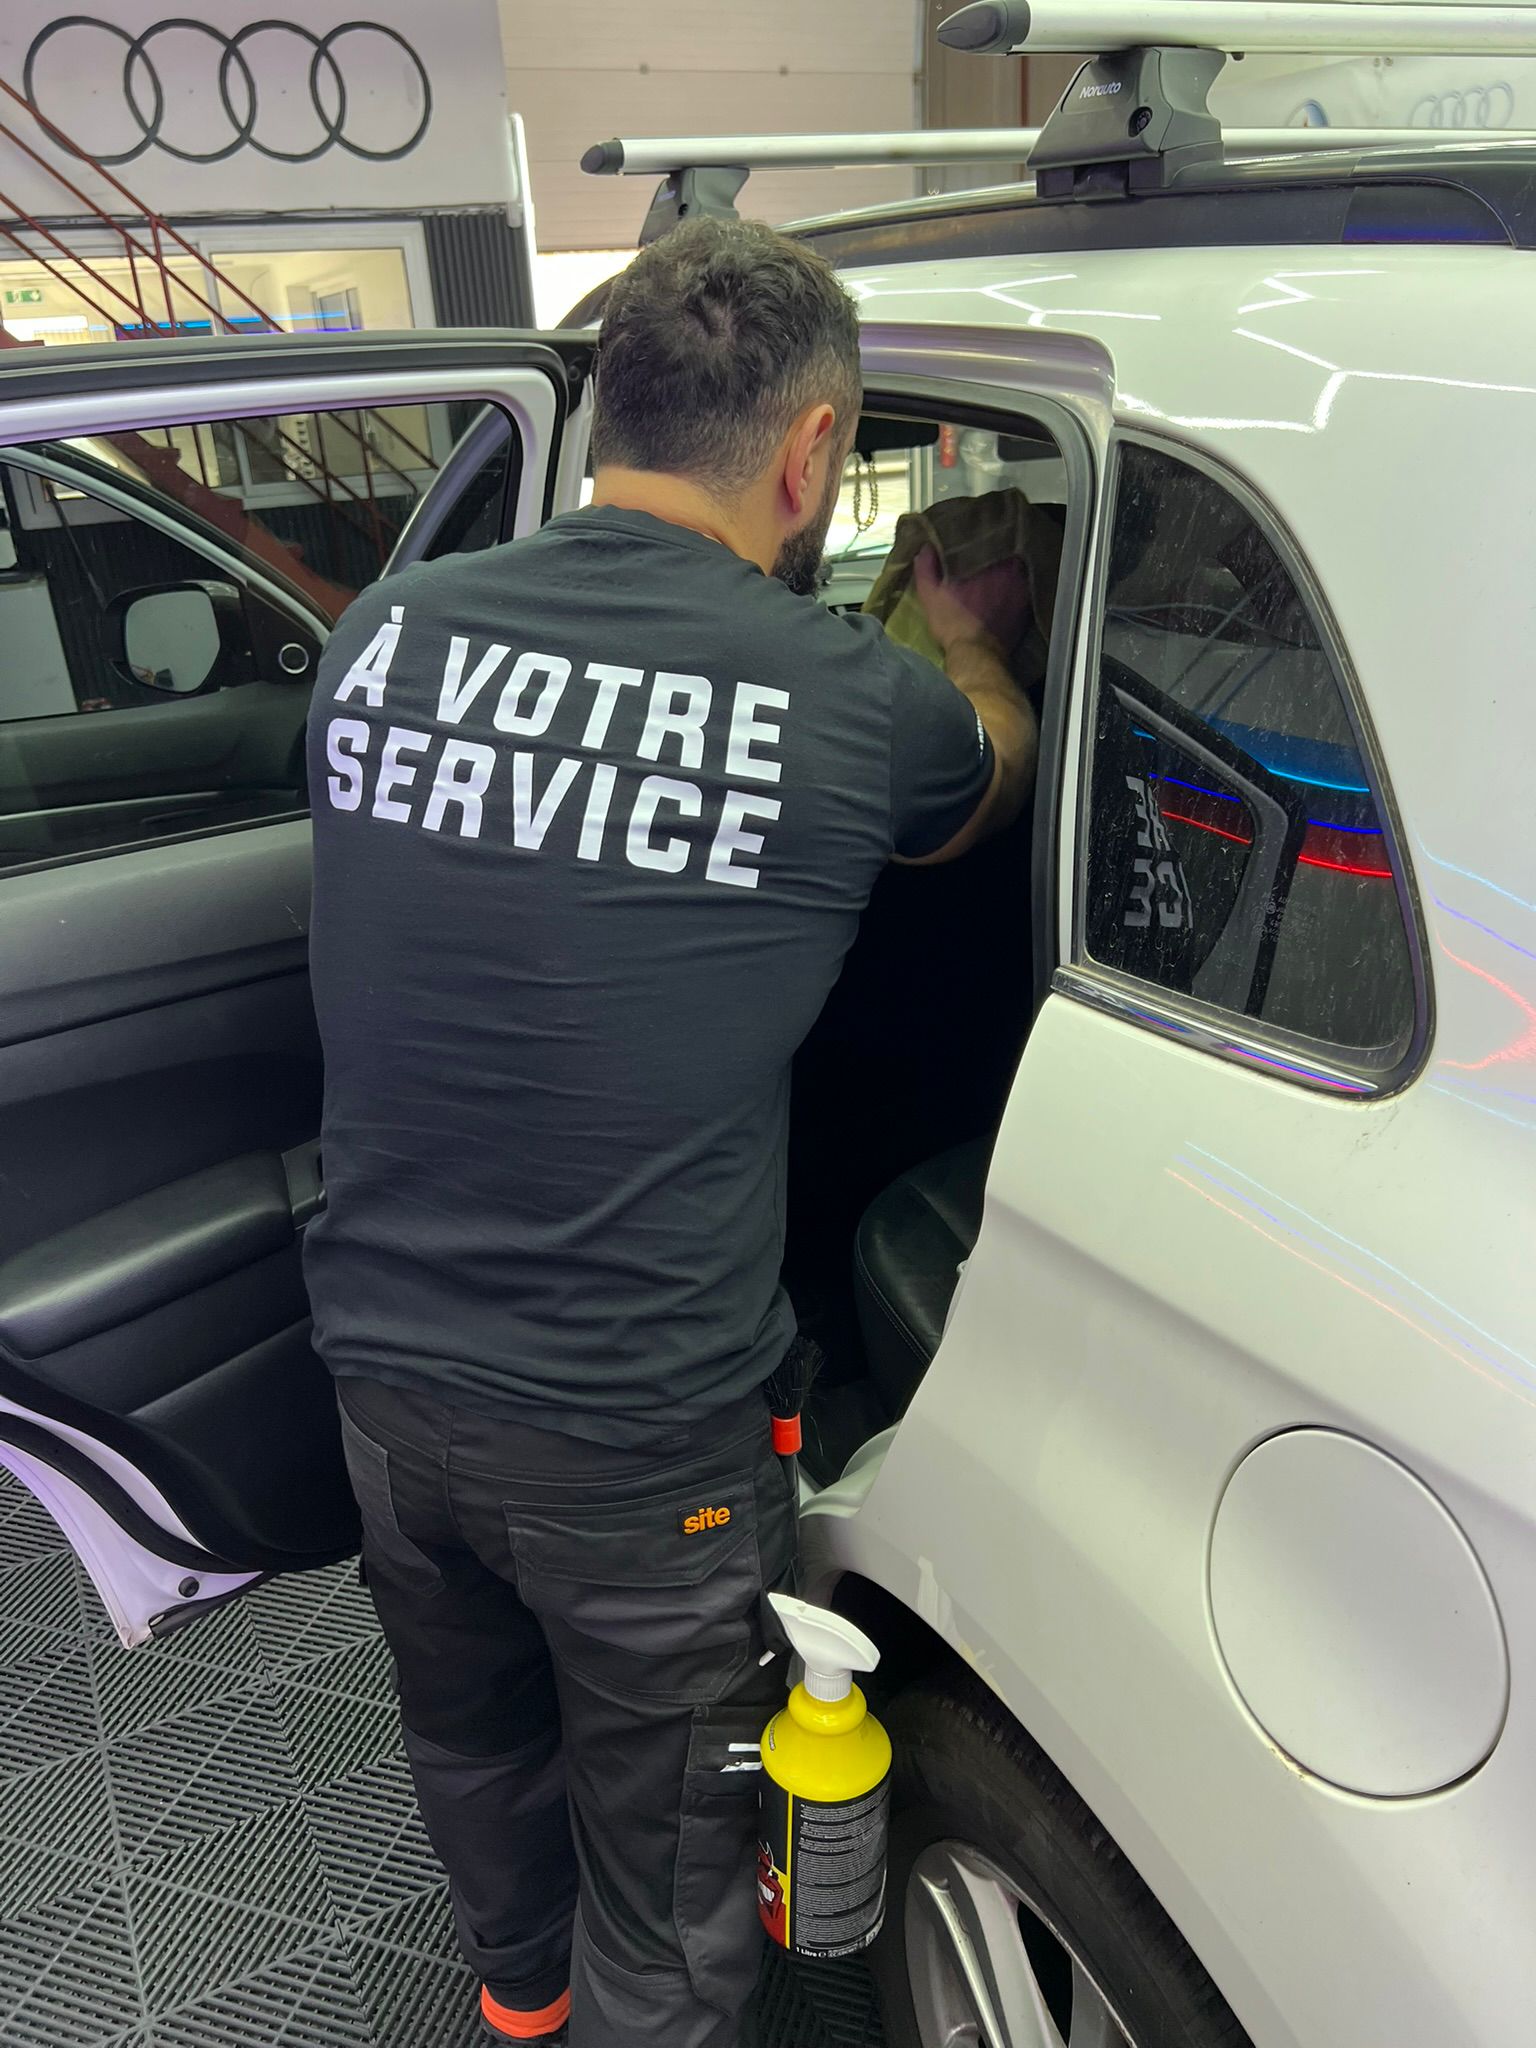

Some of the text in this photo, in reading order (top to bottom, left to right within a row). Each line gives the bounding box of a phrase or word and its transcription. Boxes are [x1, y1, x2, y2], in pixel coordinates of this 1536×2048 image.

[1079, 82, 1122, 99] Norauto
[436, 635, 791, 783] VOTRE
[326, 717, 783, 889] SERVICE
[683, 1506, 731, 1535] site
